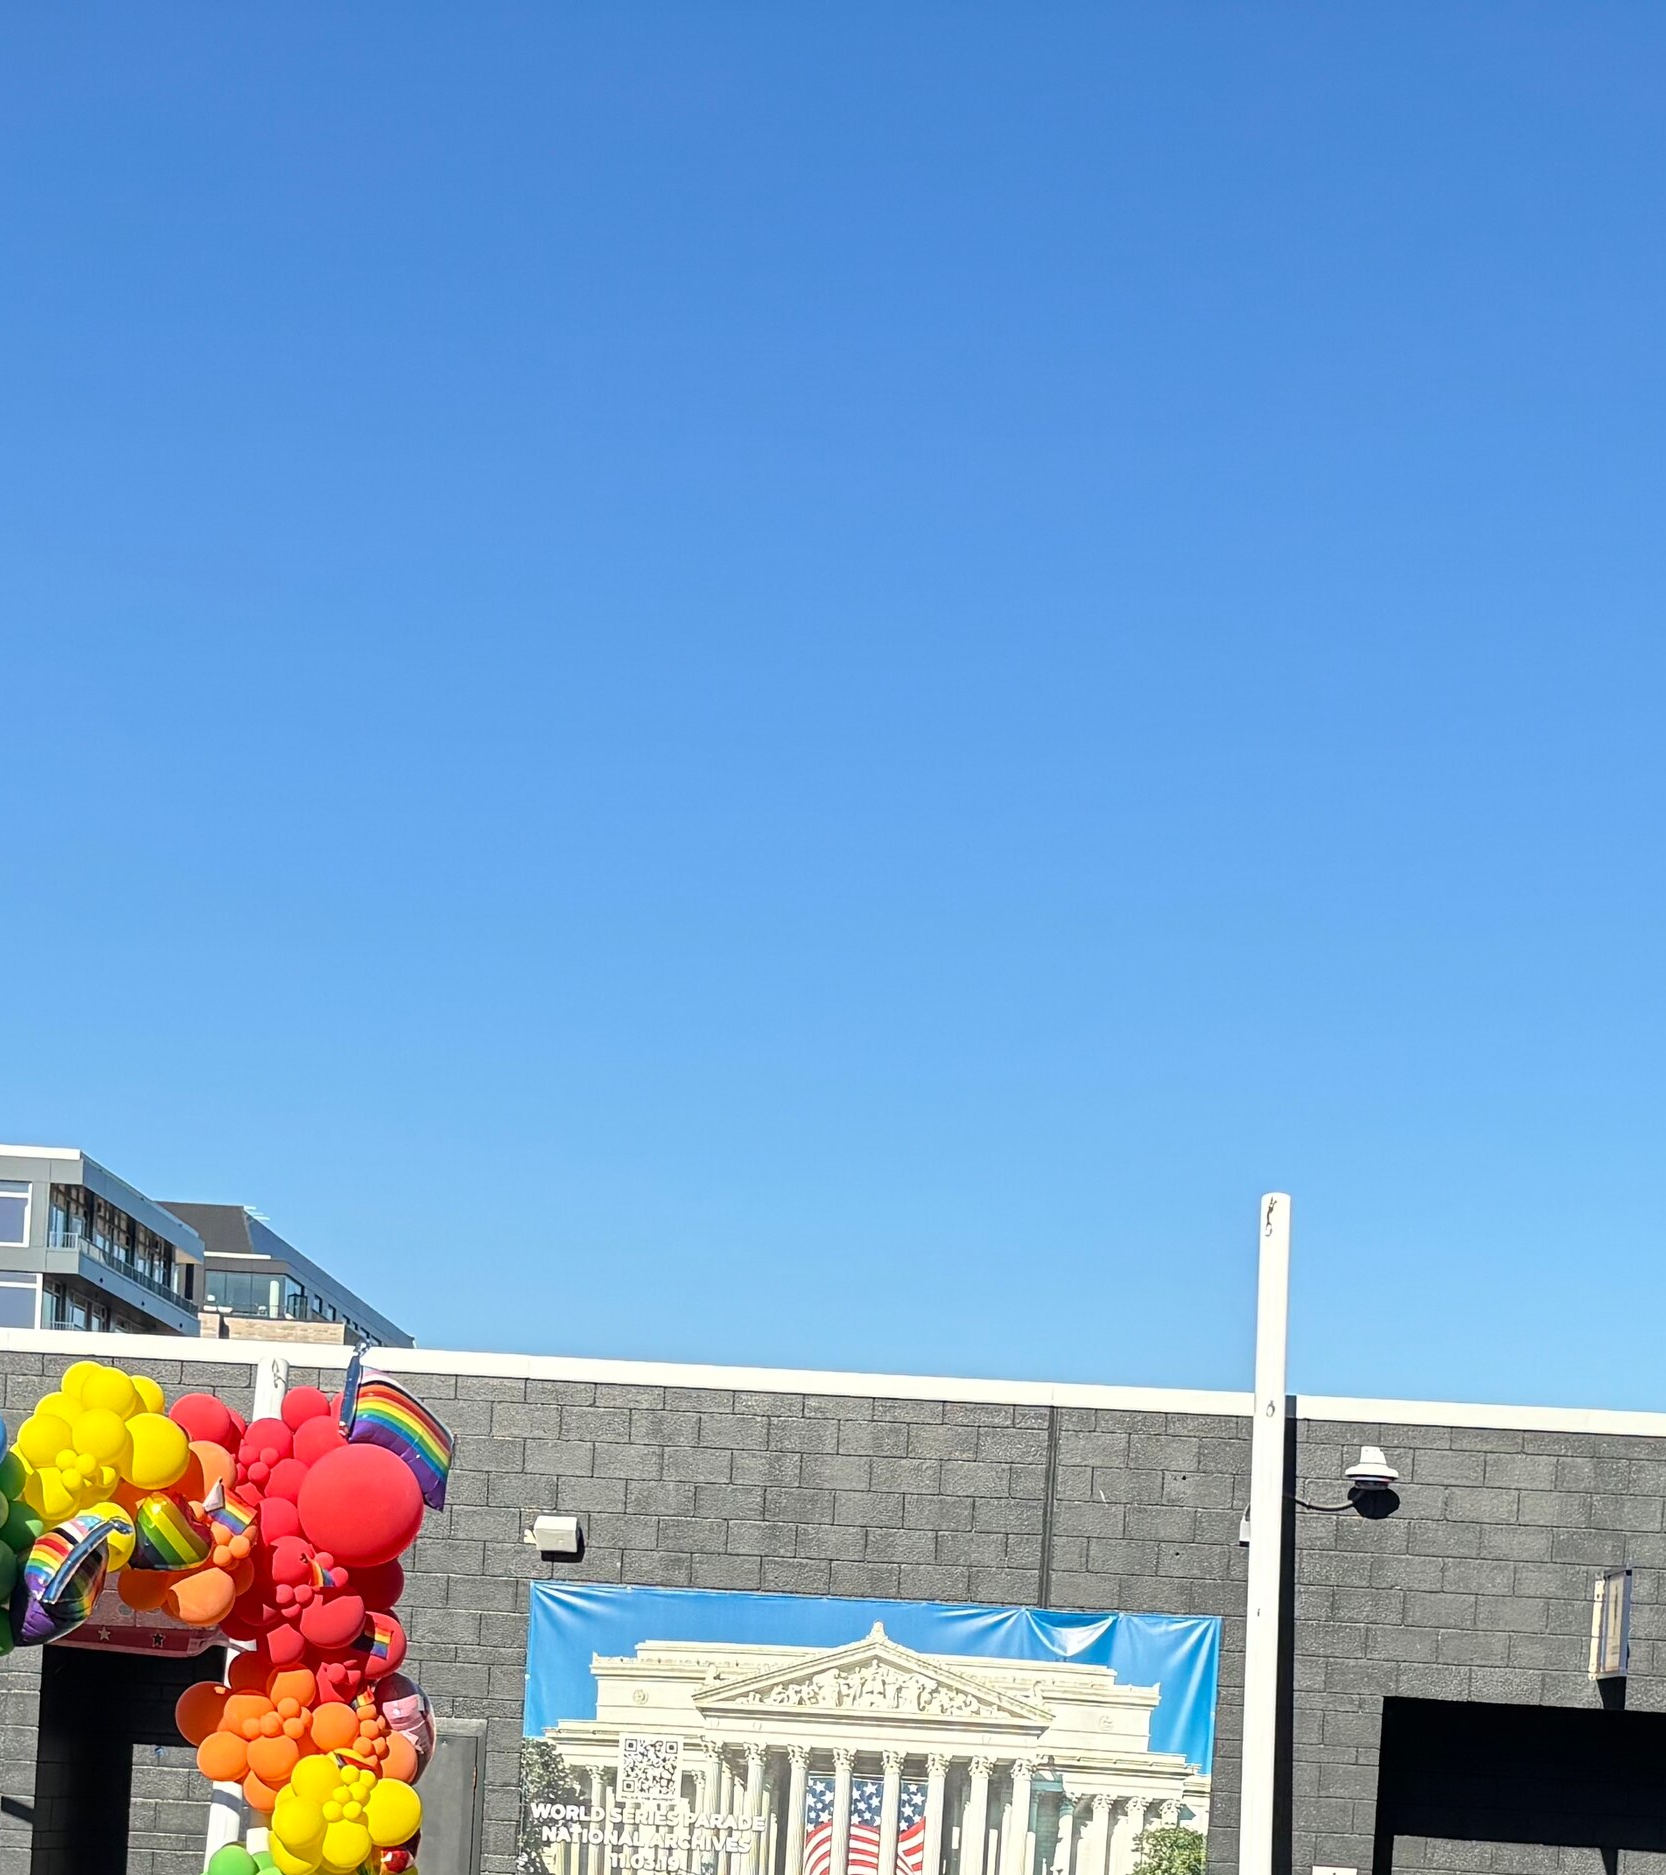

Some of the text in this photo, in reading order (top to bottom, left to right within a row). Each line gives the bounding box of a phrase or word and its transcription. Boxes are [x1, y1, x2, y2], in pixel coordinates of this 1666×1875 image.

[531, 1803, 765, 1831] WORLD SERIES PARADE
[542, 1826, 751, 1852] NATIONAL ARCHIVES
[611, 1854, 680, 1871] 11.03.19
